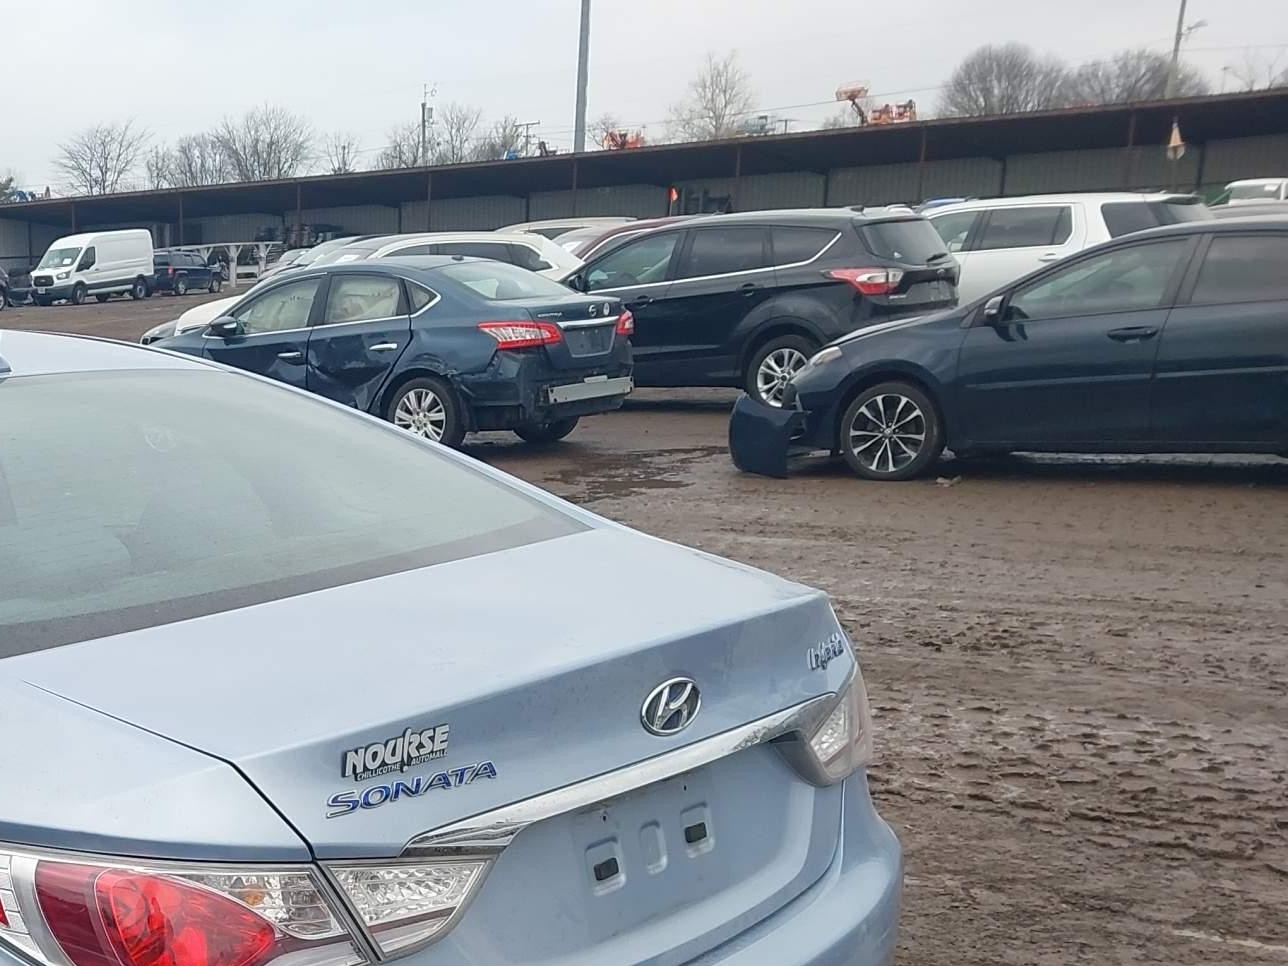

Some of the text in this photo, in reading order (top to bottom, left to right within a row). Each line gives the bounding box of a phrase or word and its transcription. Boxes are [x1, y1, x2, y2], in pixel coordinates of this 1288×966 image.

[342, 723, 450, 778] NOURSE
[357, 750, 448, 781] CHILLICOTHE AUTOMALL
[326, 760, 497, 819] SONATA
